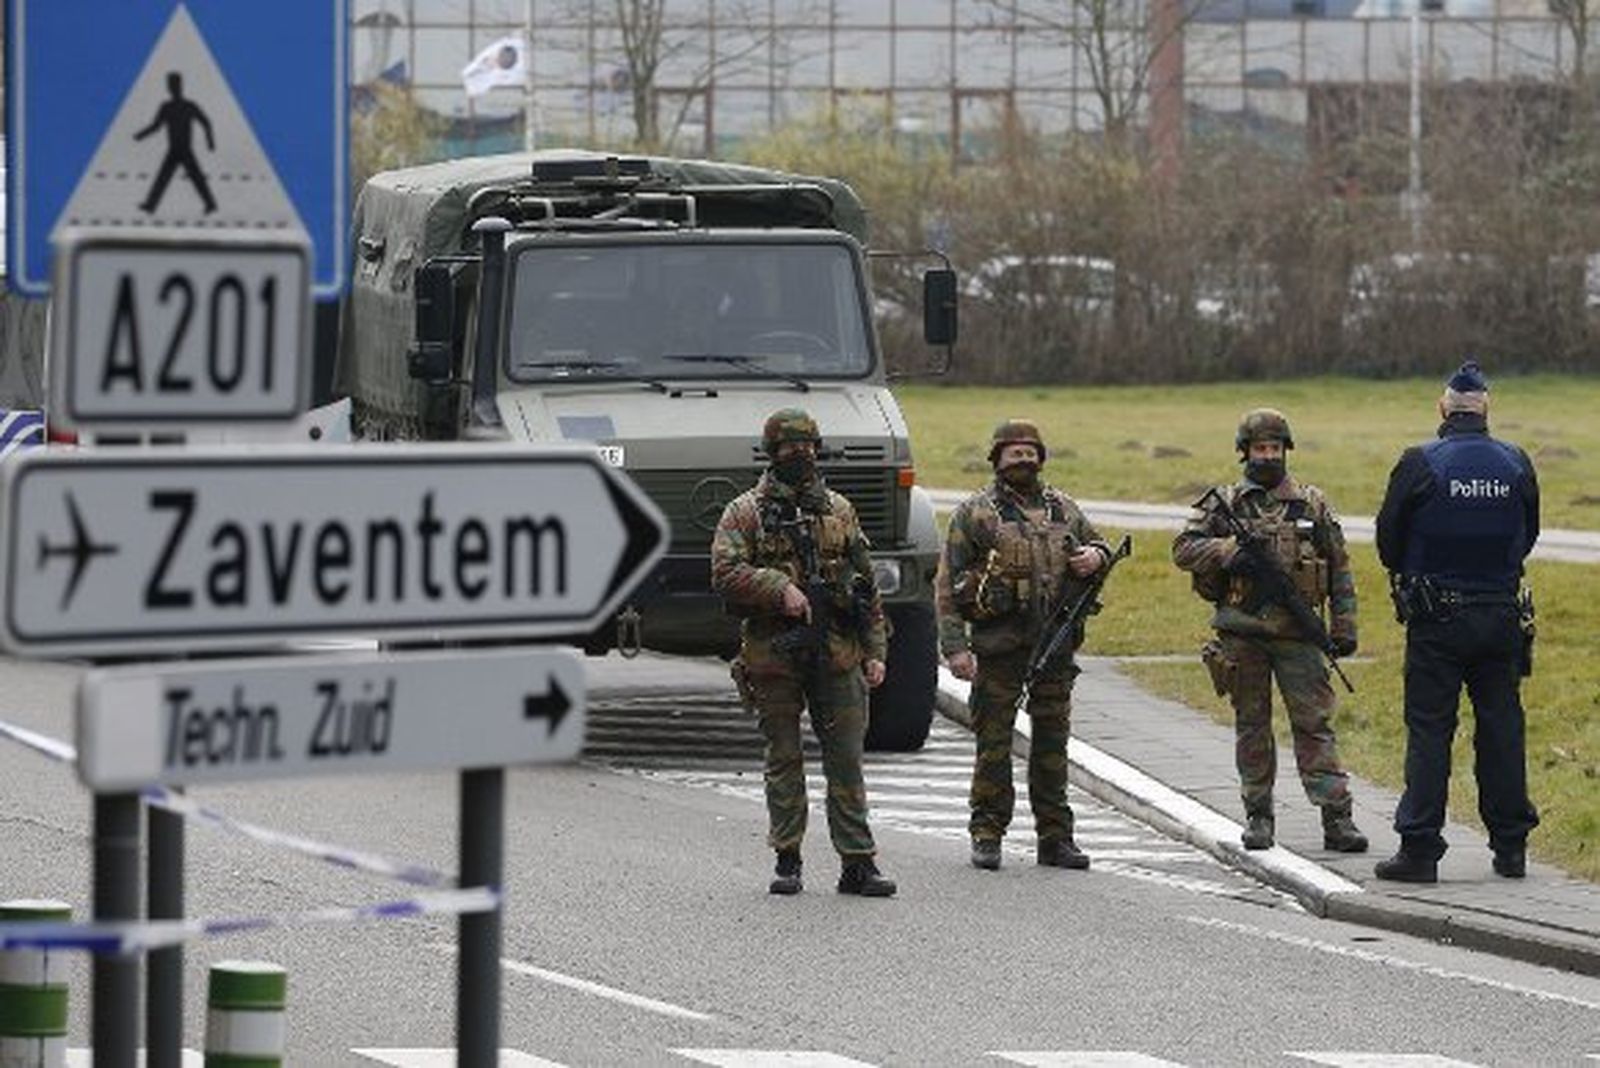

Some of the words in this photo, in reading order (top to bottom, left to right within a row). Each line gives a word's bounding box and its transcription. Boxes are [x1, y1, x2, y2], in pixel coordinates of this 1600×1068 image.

[102, 270, 278, 394] A201
[1450, 479, 1510, 497] Politie
[144, 489, 568, 609] Zaventem
[308, 678, 396, 759] Zuid
